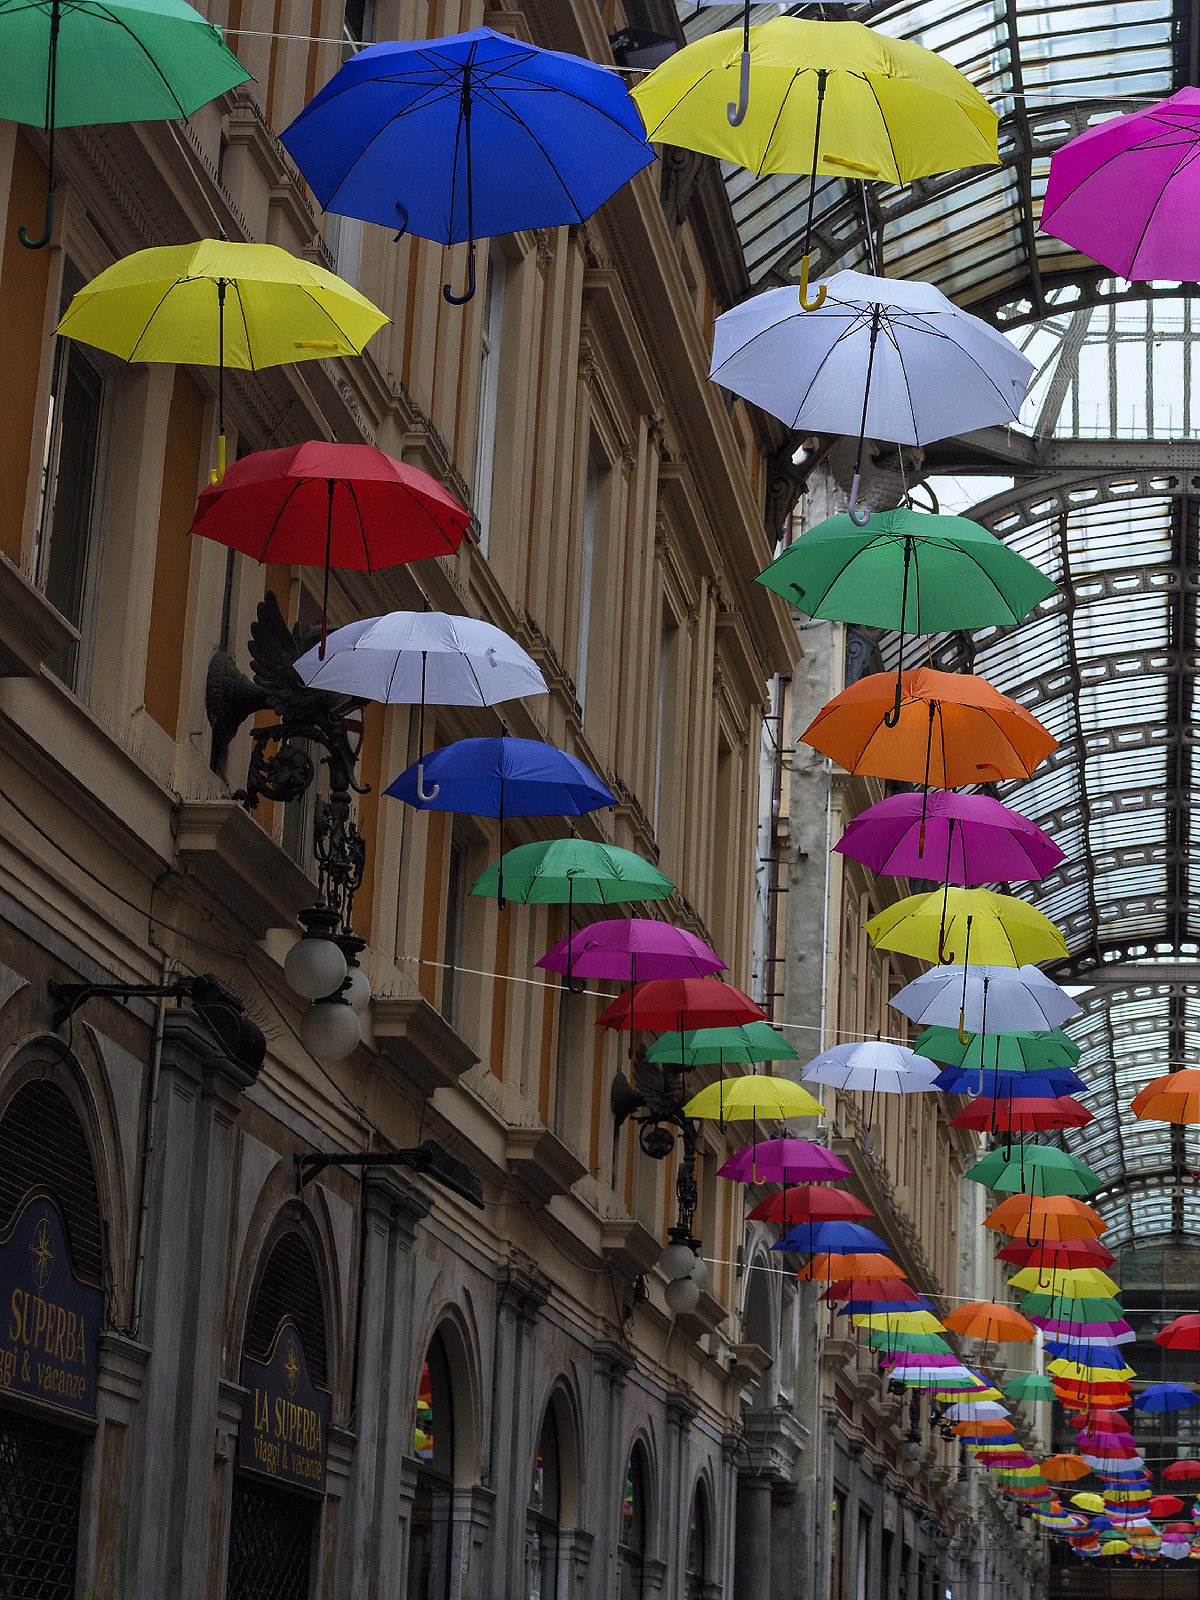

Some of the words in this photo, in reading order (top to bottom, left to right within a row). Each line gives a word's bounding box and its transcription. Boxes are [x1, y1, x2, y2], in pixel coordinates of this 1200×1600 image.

[8, 1288, 87, 1366] SUPERBA
[21, 1350, 31, 1383] &
[37, 1361, 86, 1400] vacanze
[254, 1388, 269, 1433] LA
[274, 1396, 322, 1454] SUPERBA
[254, 1434, 280, 1474] viaggi
[282, 1444, 288, 1470] &
[291, 1453, 322, 1480] vacanze
